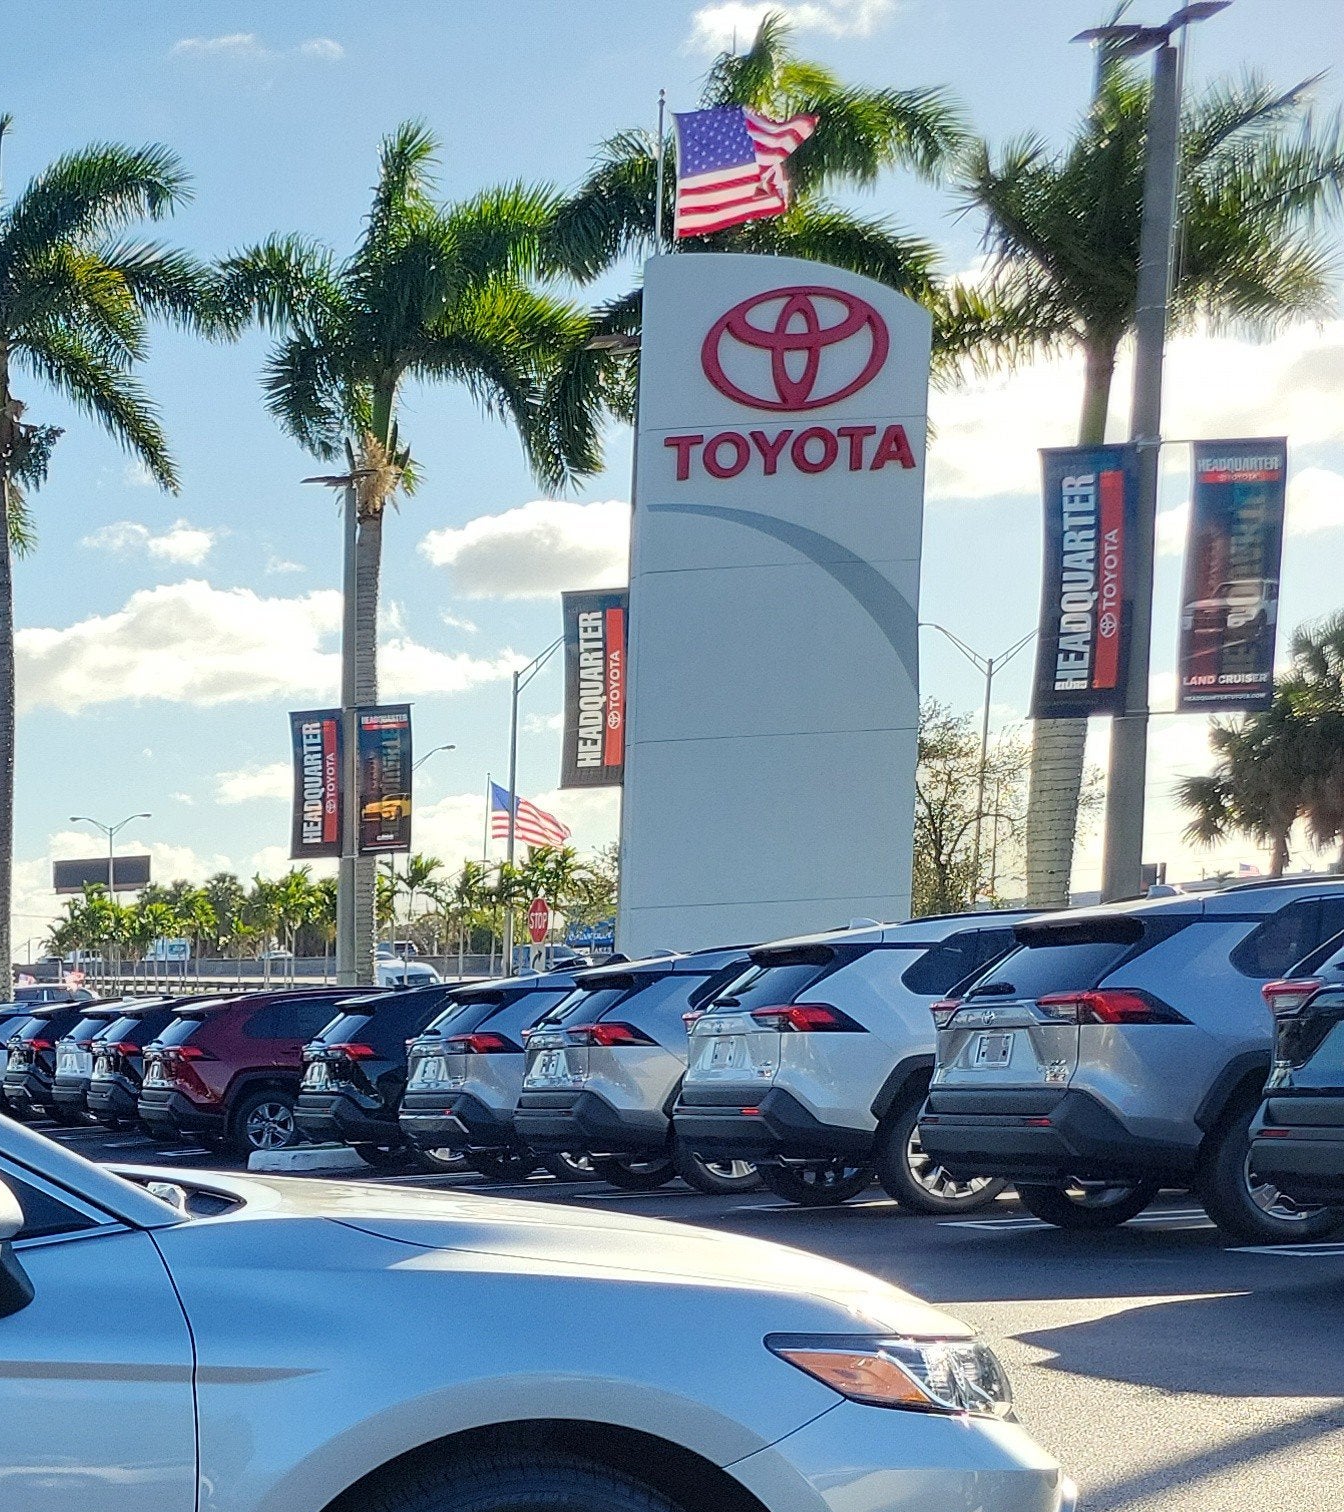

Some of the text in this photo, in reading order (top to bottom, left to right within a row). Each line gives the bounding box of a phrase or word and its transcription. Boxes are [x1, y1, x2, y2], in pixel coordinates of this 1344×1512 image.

[664, 424, 916, 481] TOYOTA
[1198, 456, 1281, 471] HEADQUARTER
[1055, 473, 1098, 691] HEADQUARTER
[1103, 529, 1119, 611] TOYOTA
[577, 611, 606, 768] HEADQUARTER
[609, 650, 621, 710] TOYOTA
[1183, 671, 1269, 685] LAND CRUISER
[302, 722, 324, 843] HEADQUARTER
[326, 753, 337, 801] TOYOTA
[530, 912, 547, 929] STOP
